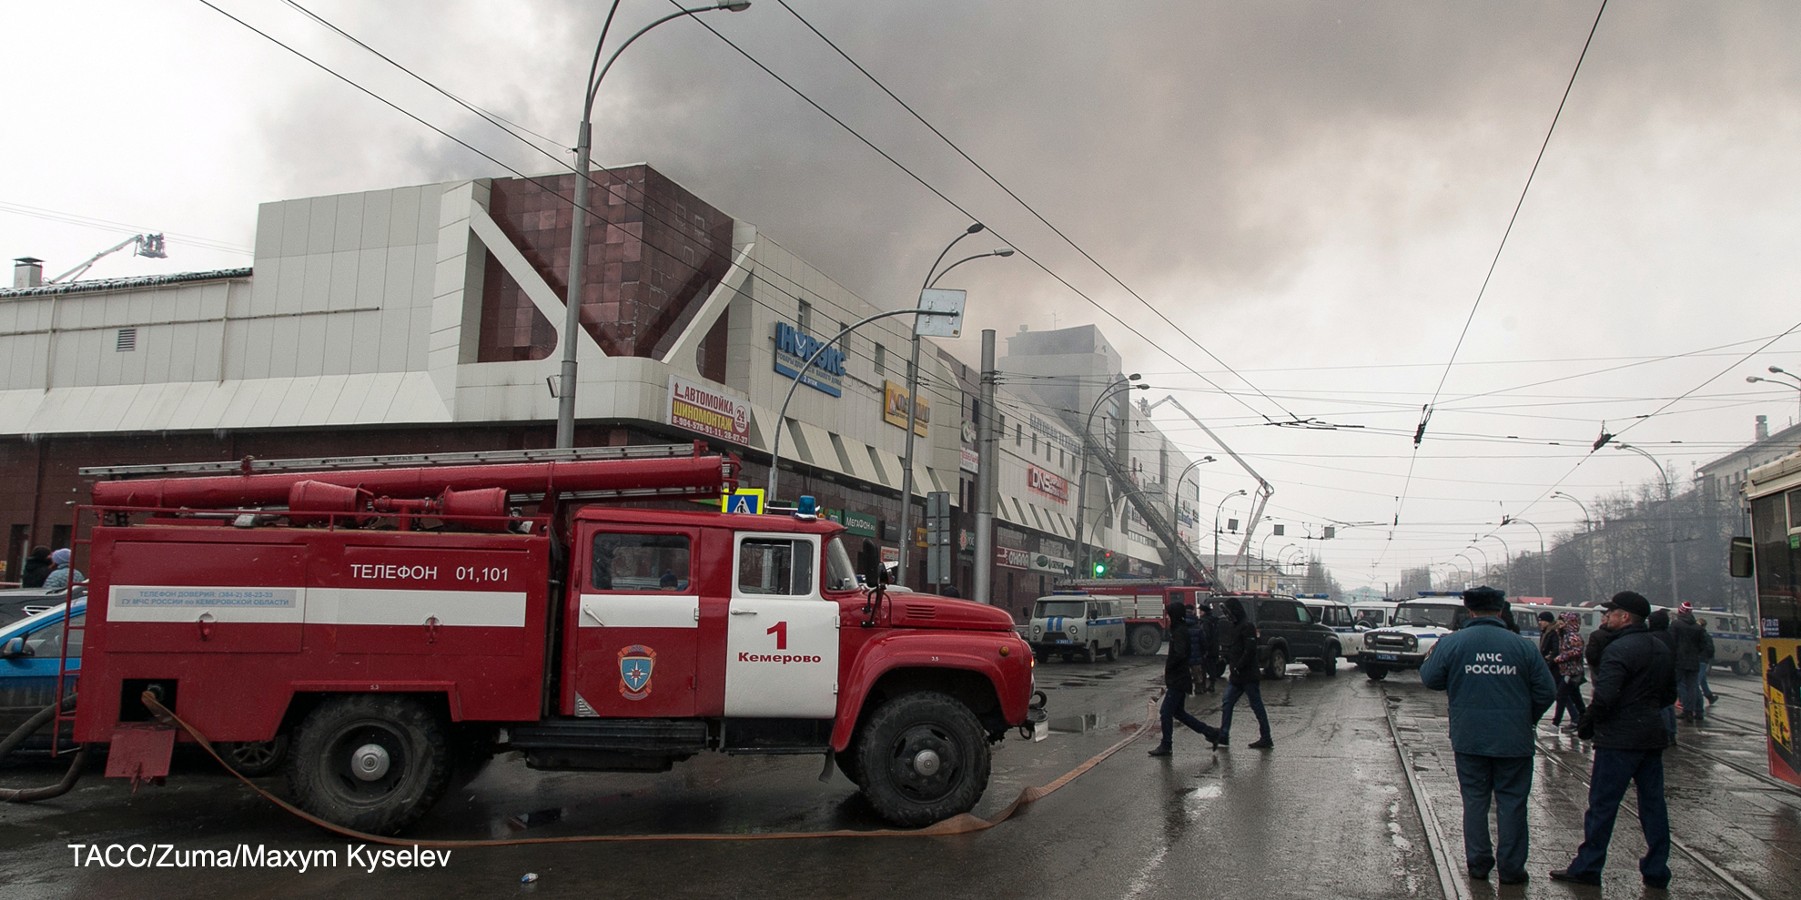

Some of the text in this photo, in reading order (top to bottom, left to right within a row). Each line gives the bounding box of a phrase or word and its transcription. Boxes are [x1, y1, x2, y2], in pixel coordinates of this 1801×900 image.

[684, 385, 734, 415] АВТОМОЙКА
[673, 399, 733, 432] ШИНОМОНТАЖ
[736, 409, 745, 422] 24
[1032, 467, 1051, 493] DNS
[350, 564, 509, 583] ТЕЛЕФОН 01,101
[767, 621, 787, 650] 1
[738, 652, 821, 664] Кемерово
[1476, 653, 1502, 662] МЧС
[1465, 664, 1517, 674] РОССИИ
